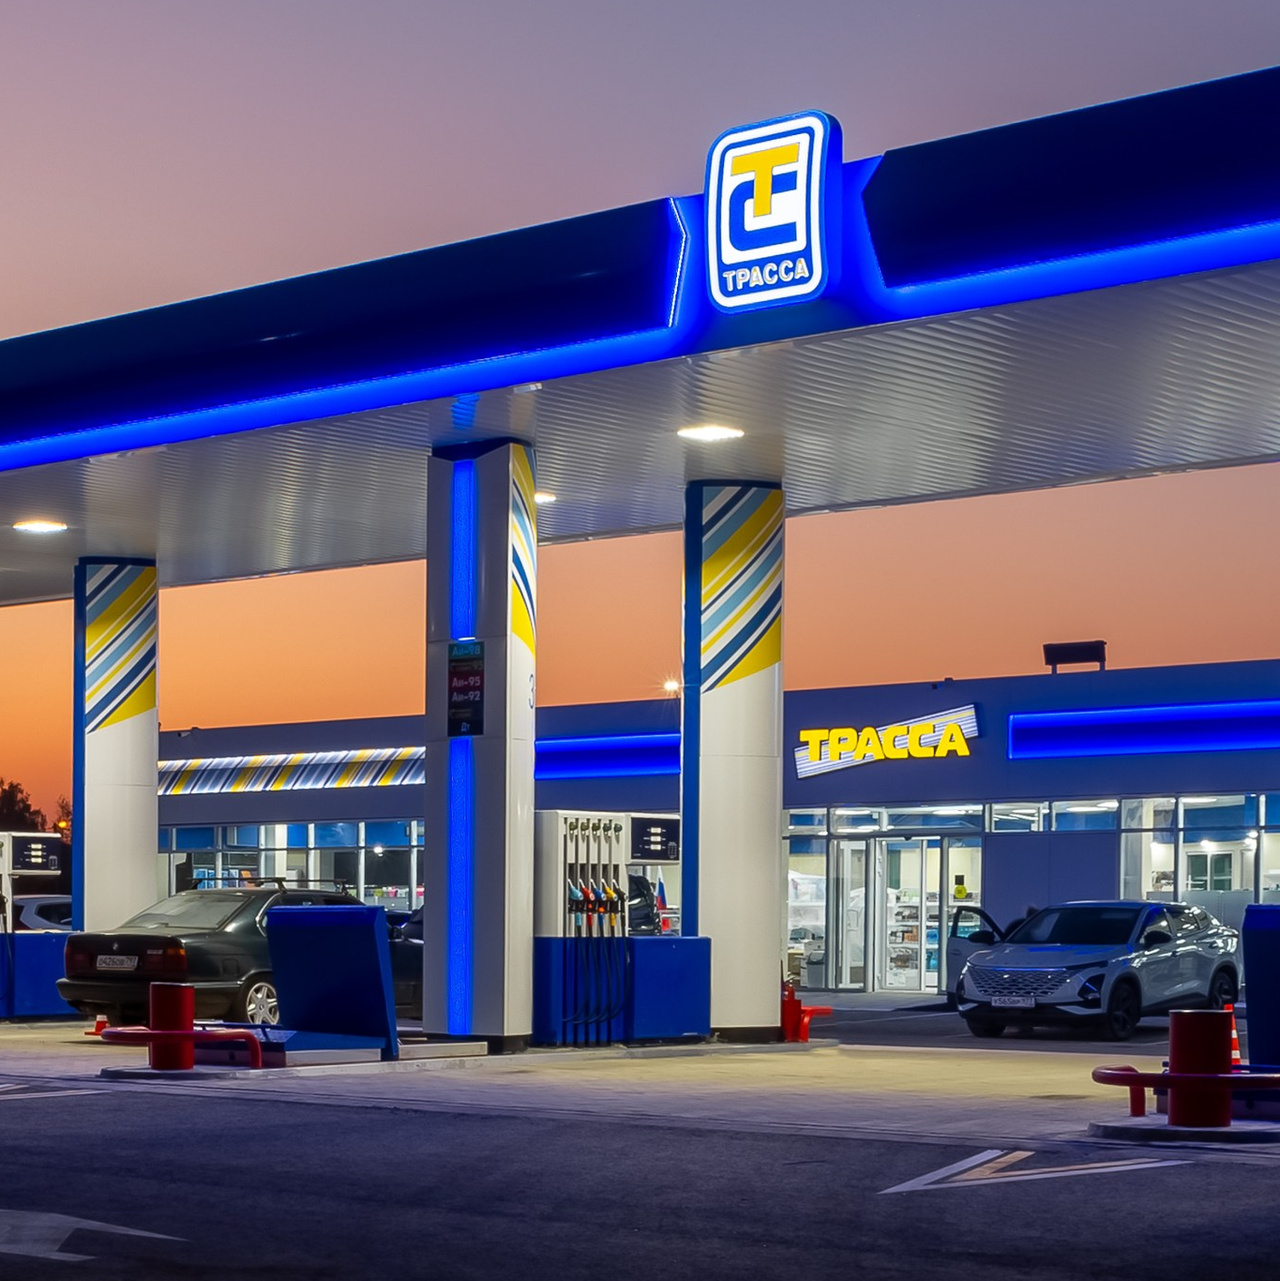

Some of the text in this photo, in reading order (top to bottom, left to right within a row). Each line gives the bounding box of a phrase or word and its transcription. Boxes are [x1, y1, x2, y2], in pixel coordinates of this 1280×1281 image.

[722, 257, 810, 292] ТРАССА
[451, 690, 481, 703] Аи-92
[452, 676, 481, 688] Аи-95
[528, 673, 535, 709] 3
[799, 723, 971, 762] ТРАССА
